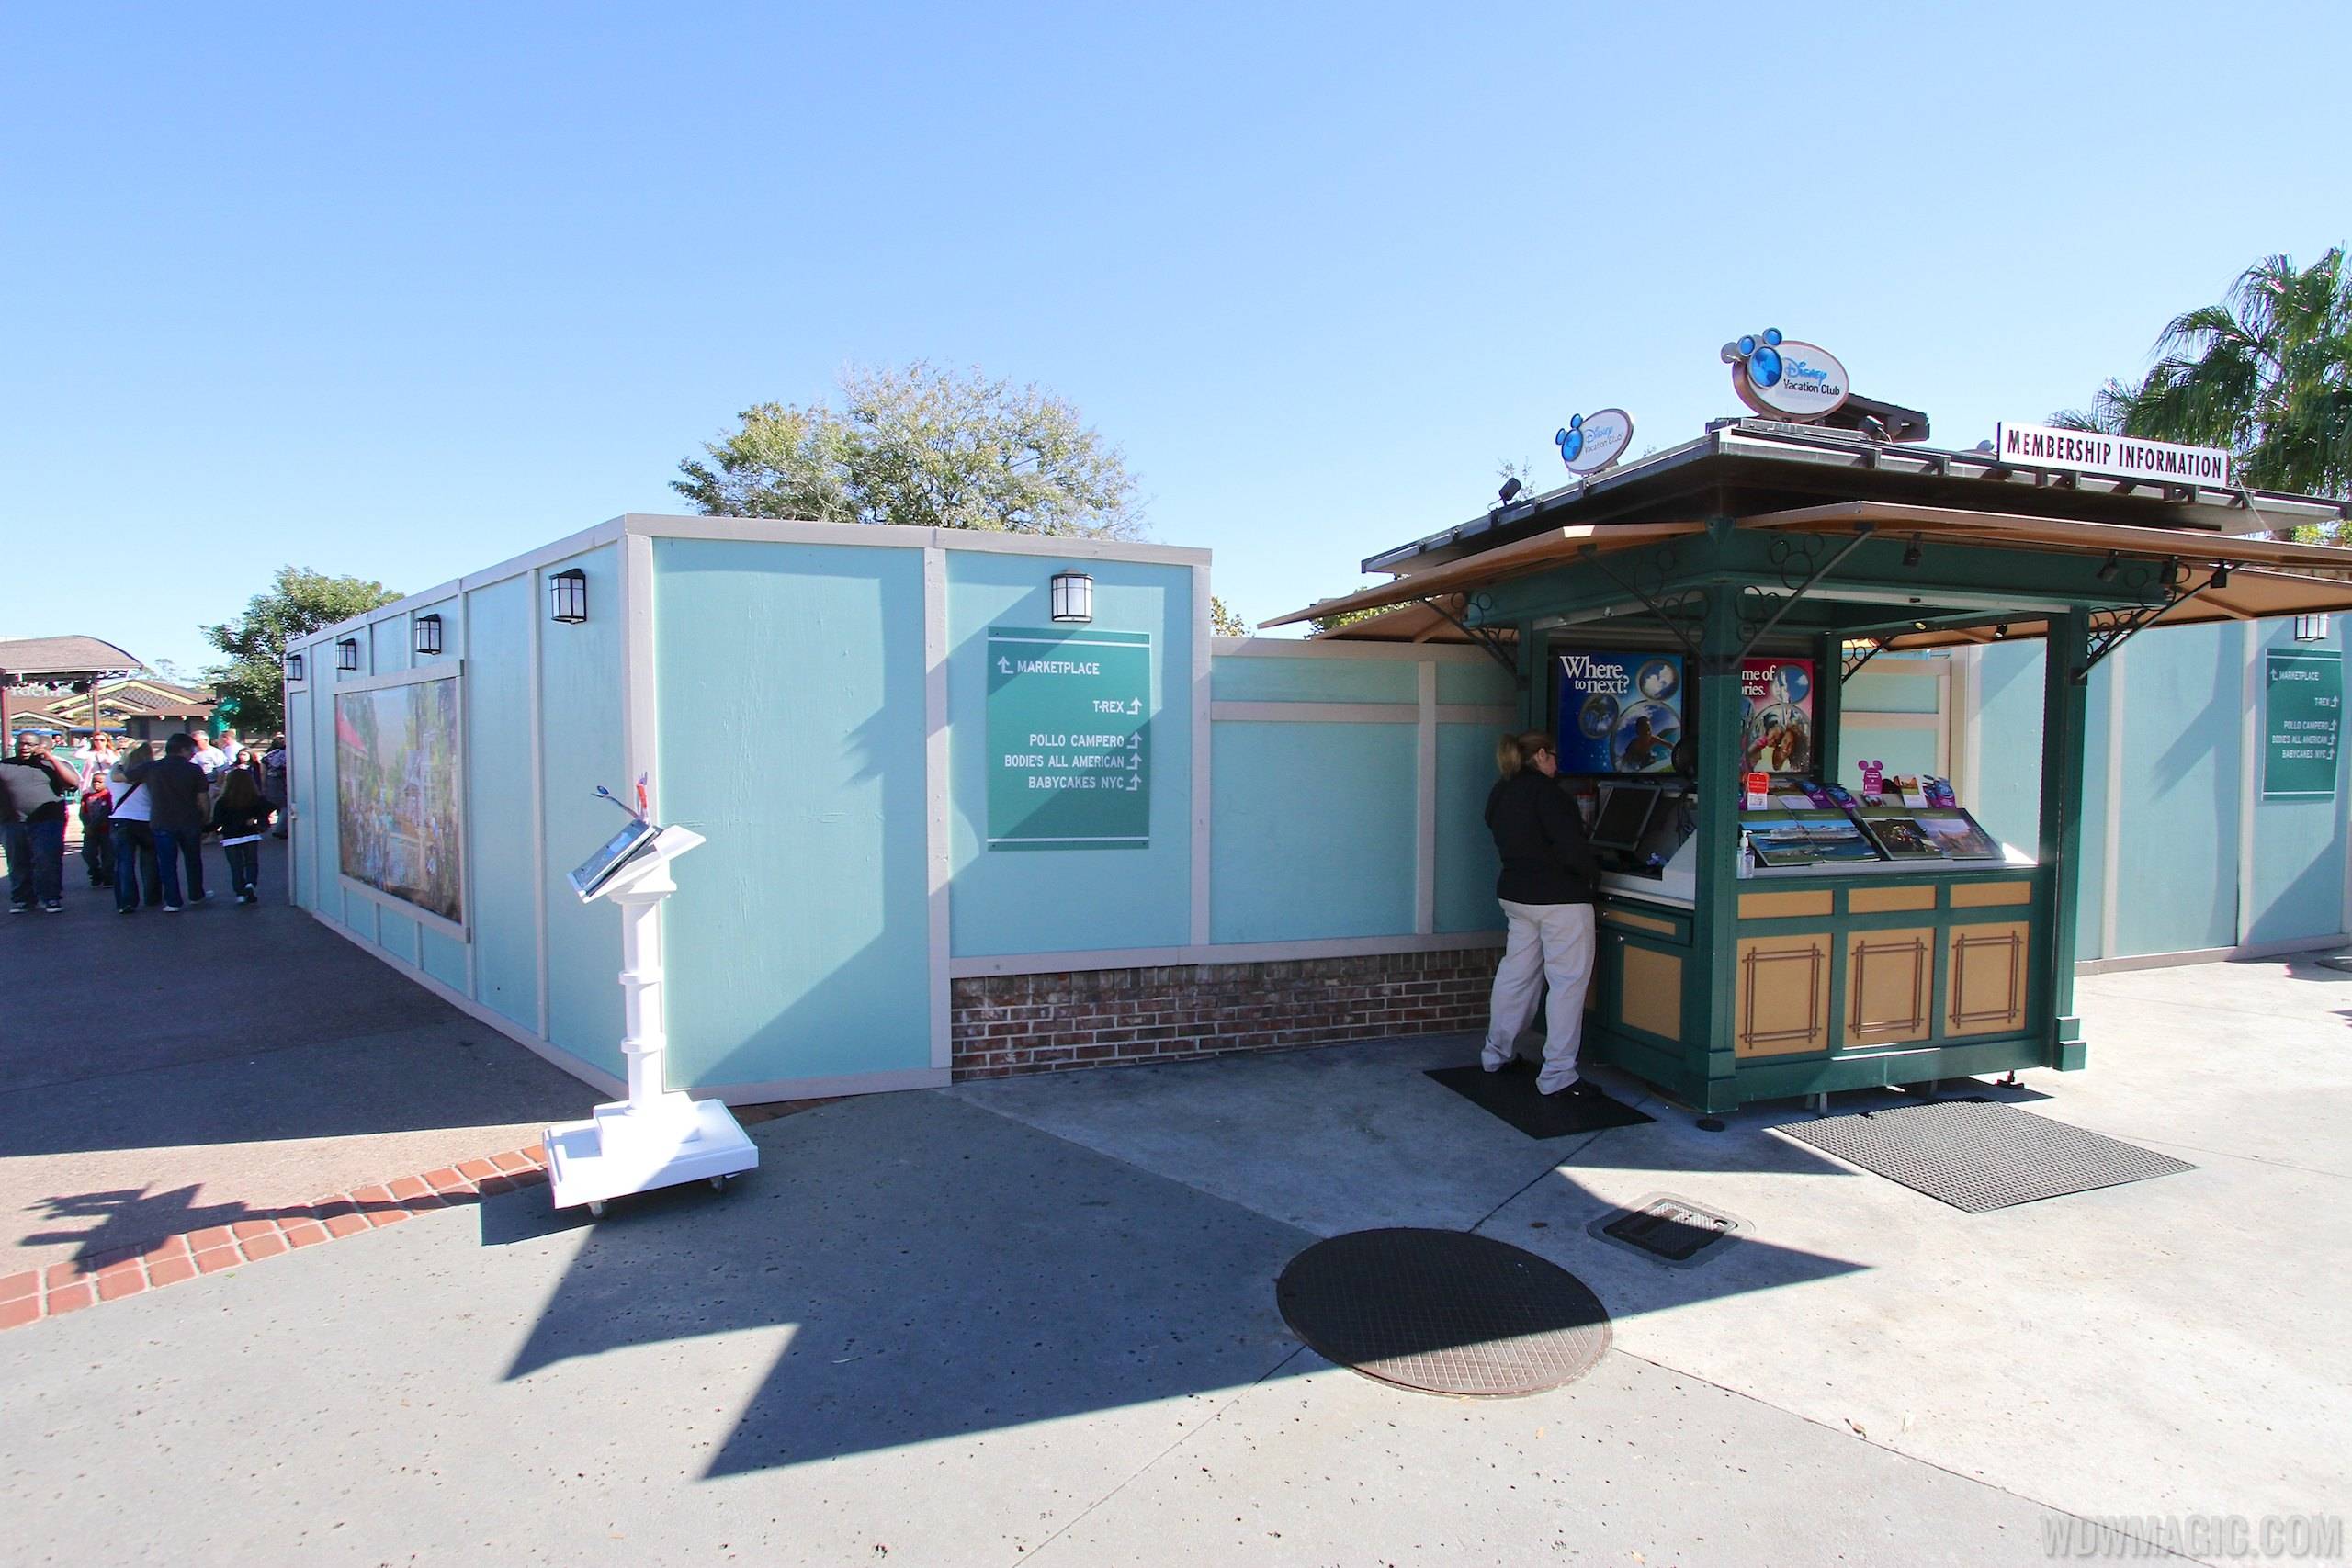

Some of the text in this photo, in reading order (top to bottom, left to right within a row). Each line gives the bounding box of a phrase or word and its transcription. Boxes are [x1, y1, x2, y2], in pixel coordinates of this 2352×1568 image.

[1781, 357, 1827, 386] Disney
[1783, 378, 1840, 396] Vacation Club
[2007, 429, 2222, 479] MEMBERSHIP INFORMATION
[1017, 660, 1101, 675] MARKETPLACE
[1559, 655, 1623, 679] Where
[1741, 664, 1777, 682] me of
[2278, 671, 2320, 681] MARKETPLACE
[1575, 675, 1630, 694] to next?
[1741, 682, 1766, 696] ries.
[1092, 700, 1125, 713] T-REX
[2283, 721, 2329, 730] POLLO CAMPERO
[1029, 734, 1125, 748] POLLO CAMPERO
[2291, 735, 2301, 744] ALL
[2302, 736, 2328, 744] AMERICAN
[2281, 749, 2313, 759] BABYCAKES
[1048, 755, 1068, 768] ALL
[1072, 756, 1125, 768] AMERICAN
[1028, 776, 1124, 789] BABYCAKES NYC
